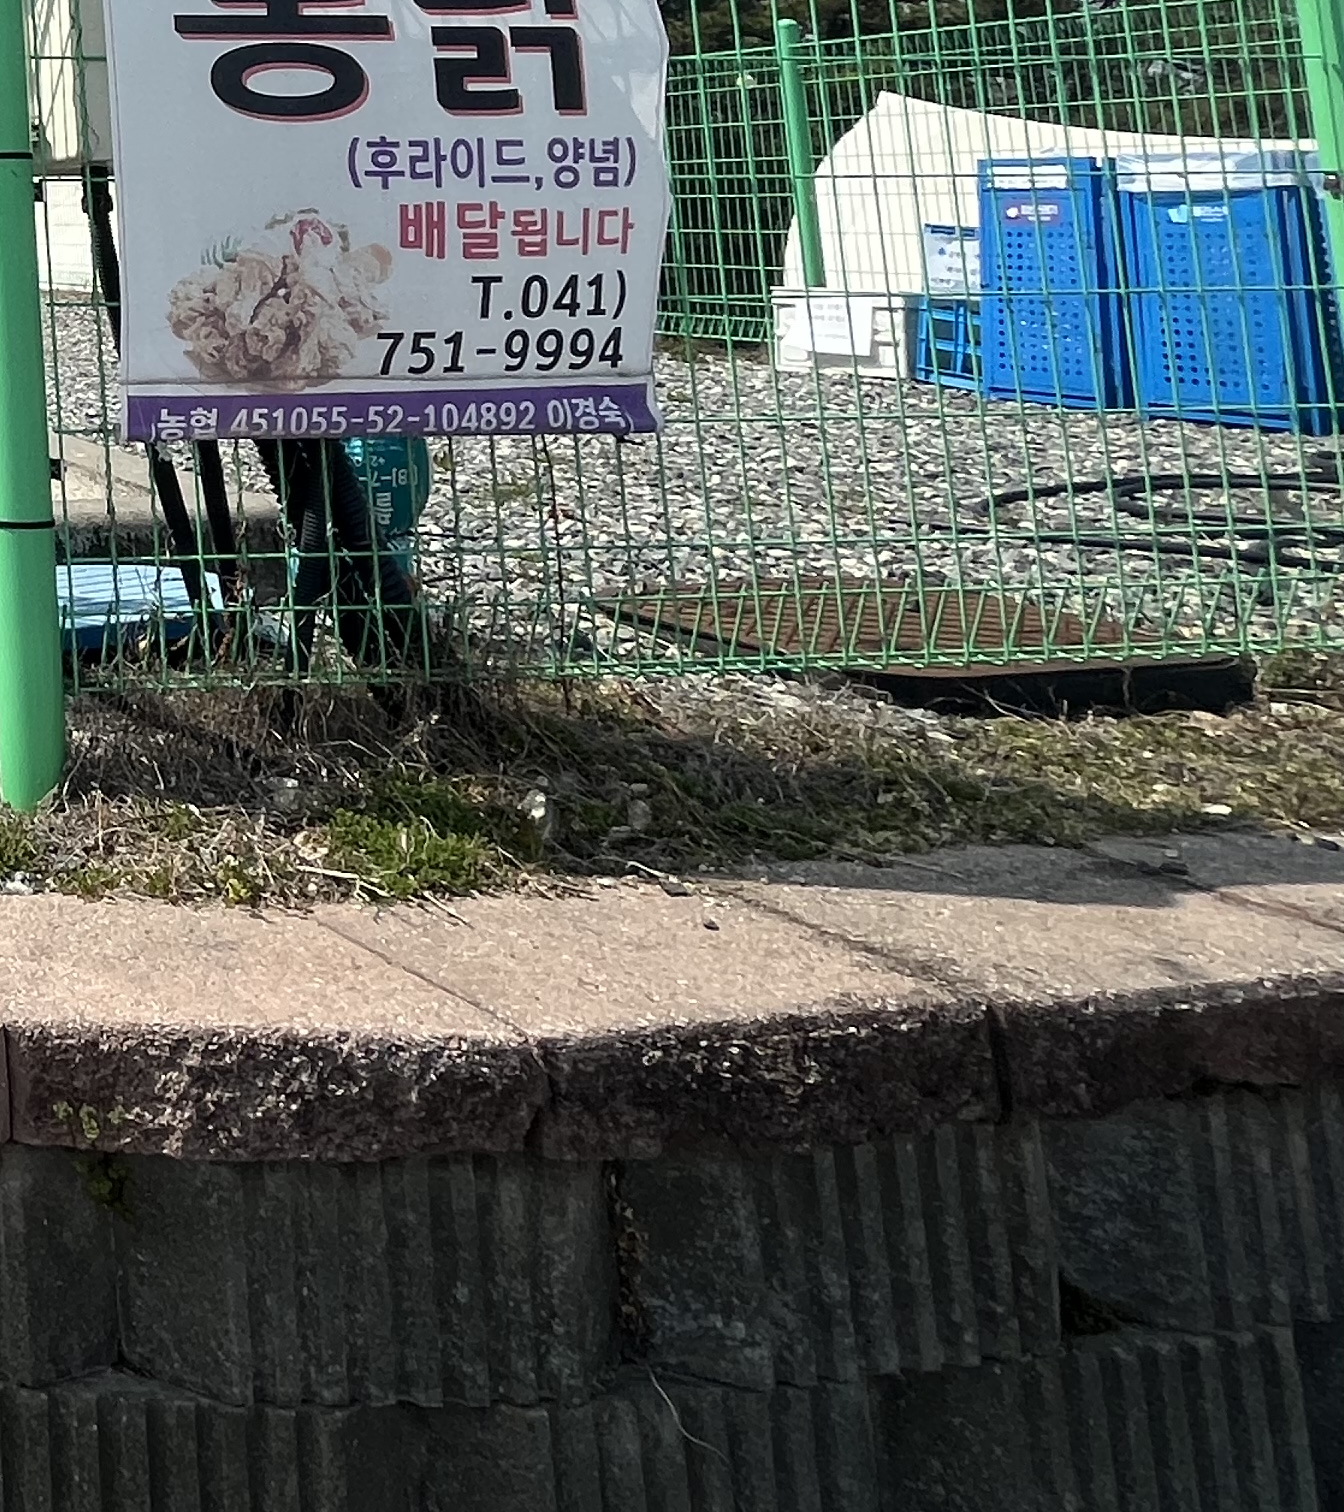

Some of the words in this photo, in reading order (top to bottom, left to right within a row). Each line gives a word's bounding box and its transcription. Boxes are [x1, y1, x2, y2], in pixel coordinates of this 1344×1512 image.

[347, 135, 637, 190] (후라이드,양념)
[398, 200, 635, 260] 배달됩니다
[470, 269, 627, 321] T.041)
[376, 325, 624, 376] 751-9994
[156, 406, 218, 440] 농협
[230, 400, 535, 437] 451055-52-104892
